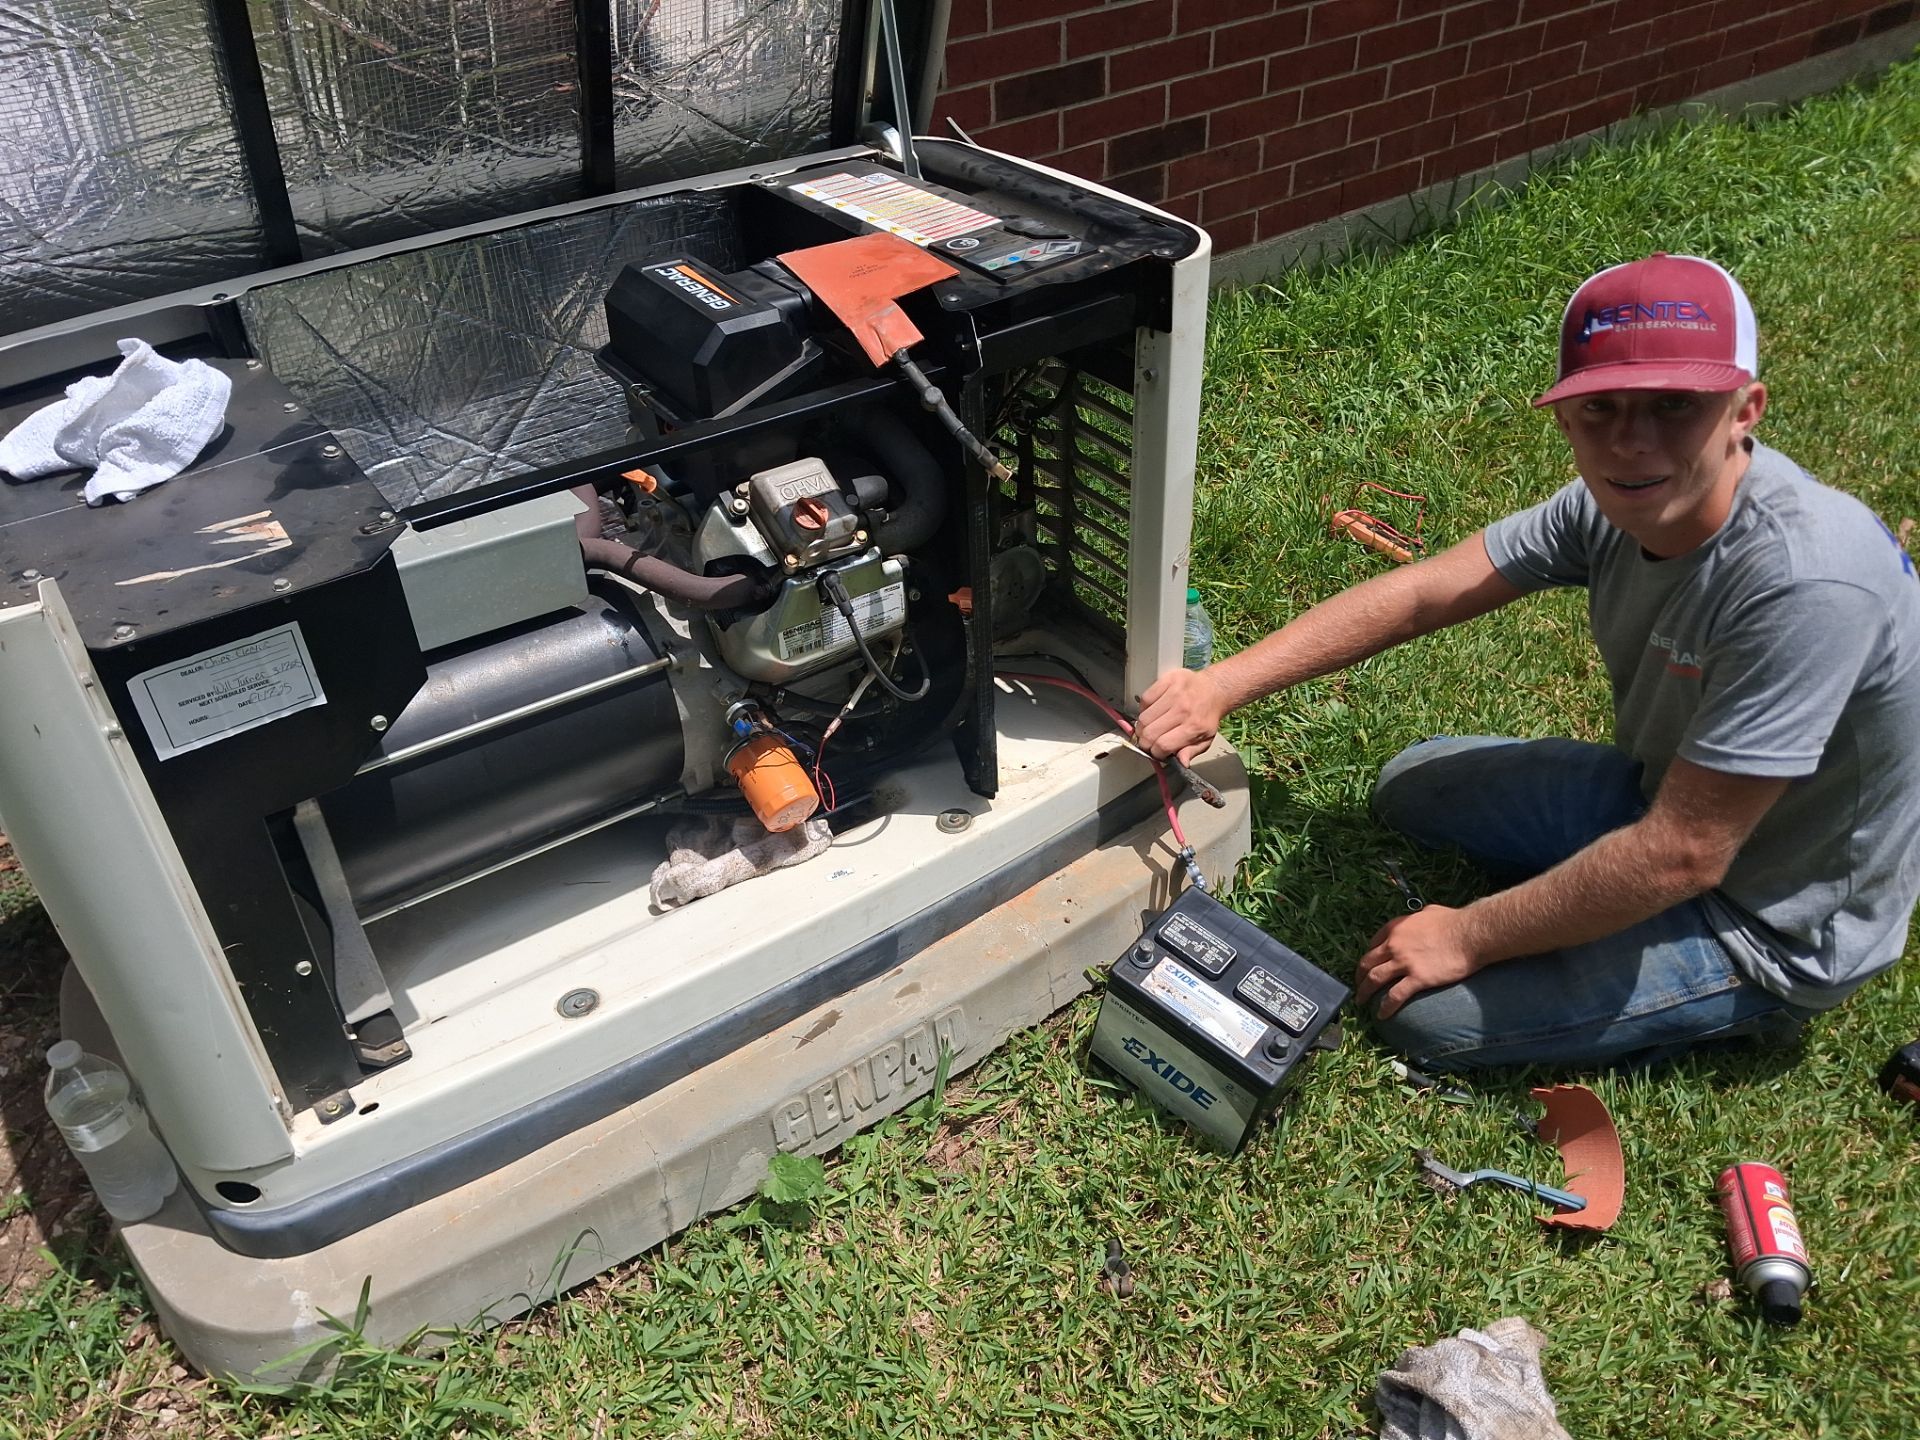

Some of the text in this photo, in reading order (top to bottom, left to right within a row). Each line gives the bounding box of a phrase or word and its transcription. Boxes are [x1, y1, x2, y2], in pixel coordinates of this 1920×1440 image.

[654, 267, 732, 310] GENERAC
[1600, 301, 1712, 323] GENTEX
[1614, 320, 1717, 332] ELITE SERVICES LLC
[780, 474, 830, 500] OHVI
[178, 694, 206, 707] SERVICED
[198, 679, 269, 707] NEXT SCHEDULED SERVICE
[1165, 964, 1199, 989] EXIDE
[772, 1007, 968, 1152] GENPAD
[1121, 1036, 1218, 1111] EXIDE
